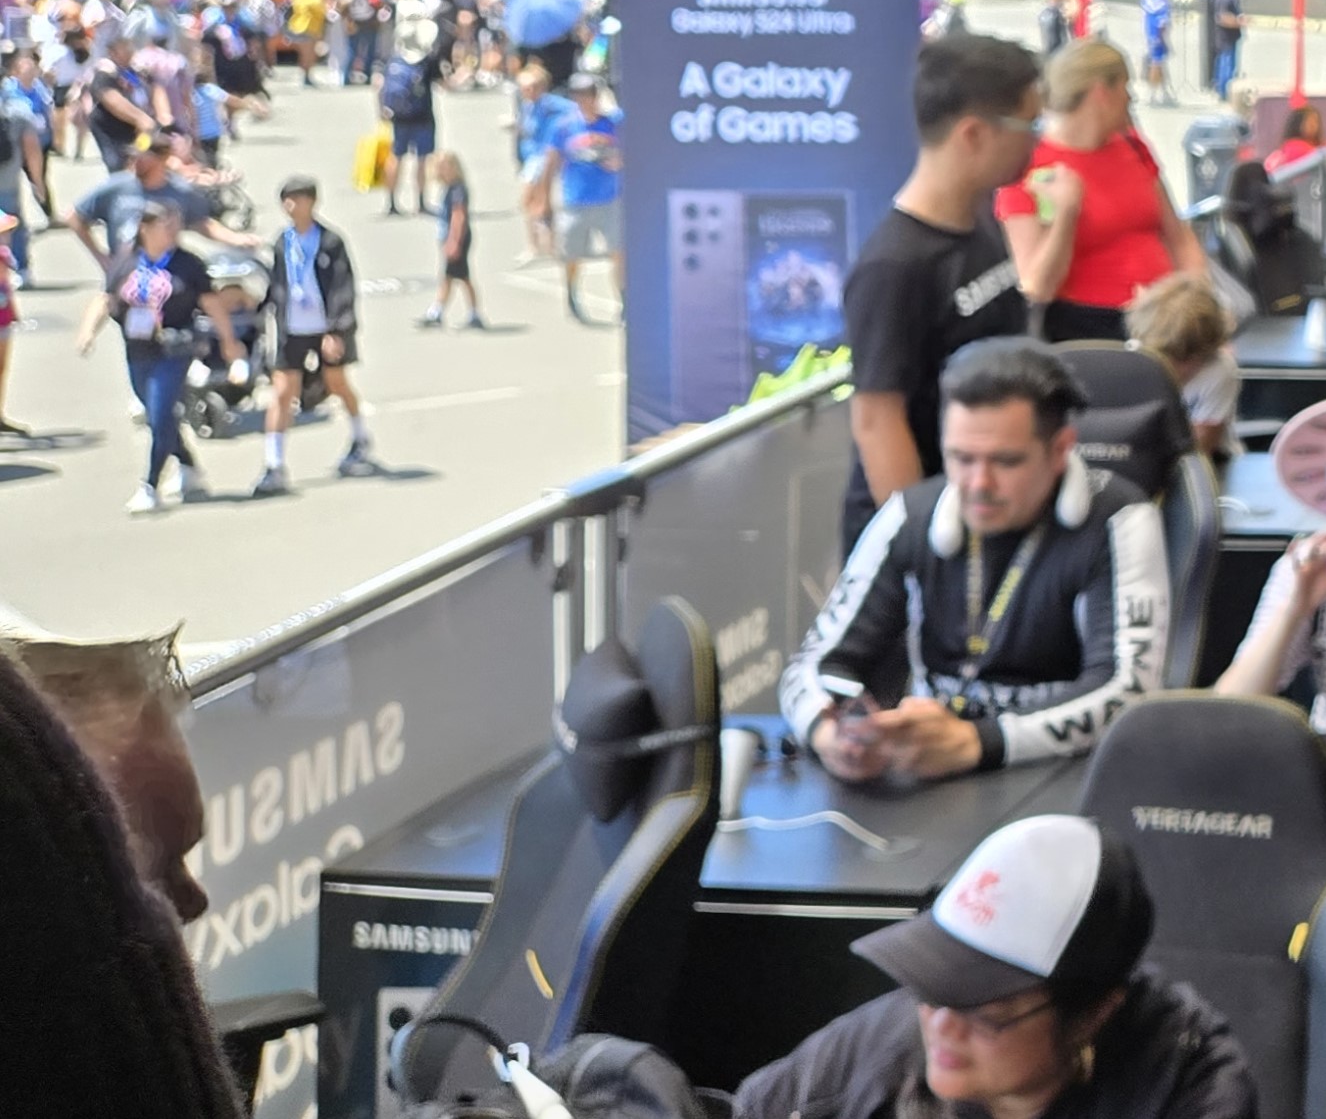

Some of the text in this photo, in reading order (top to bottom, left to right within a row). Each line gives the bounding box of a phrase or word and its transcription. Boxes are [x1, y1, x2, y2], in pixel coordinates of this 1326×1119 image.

[671, 7, 856, 39] Galaxy S24 Ultra
[679, 61, 852, 108] A Galaxy
[671, 102, 860, 144] of Games
[1131, 805, 1273, 839] VERTAGEAR
[353, 921, 480, 957] SAMSUN
